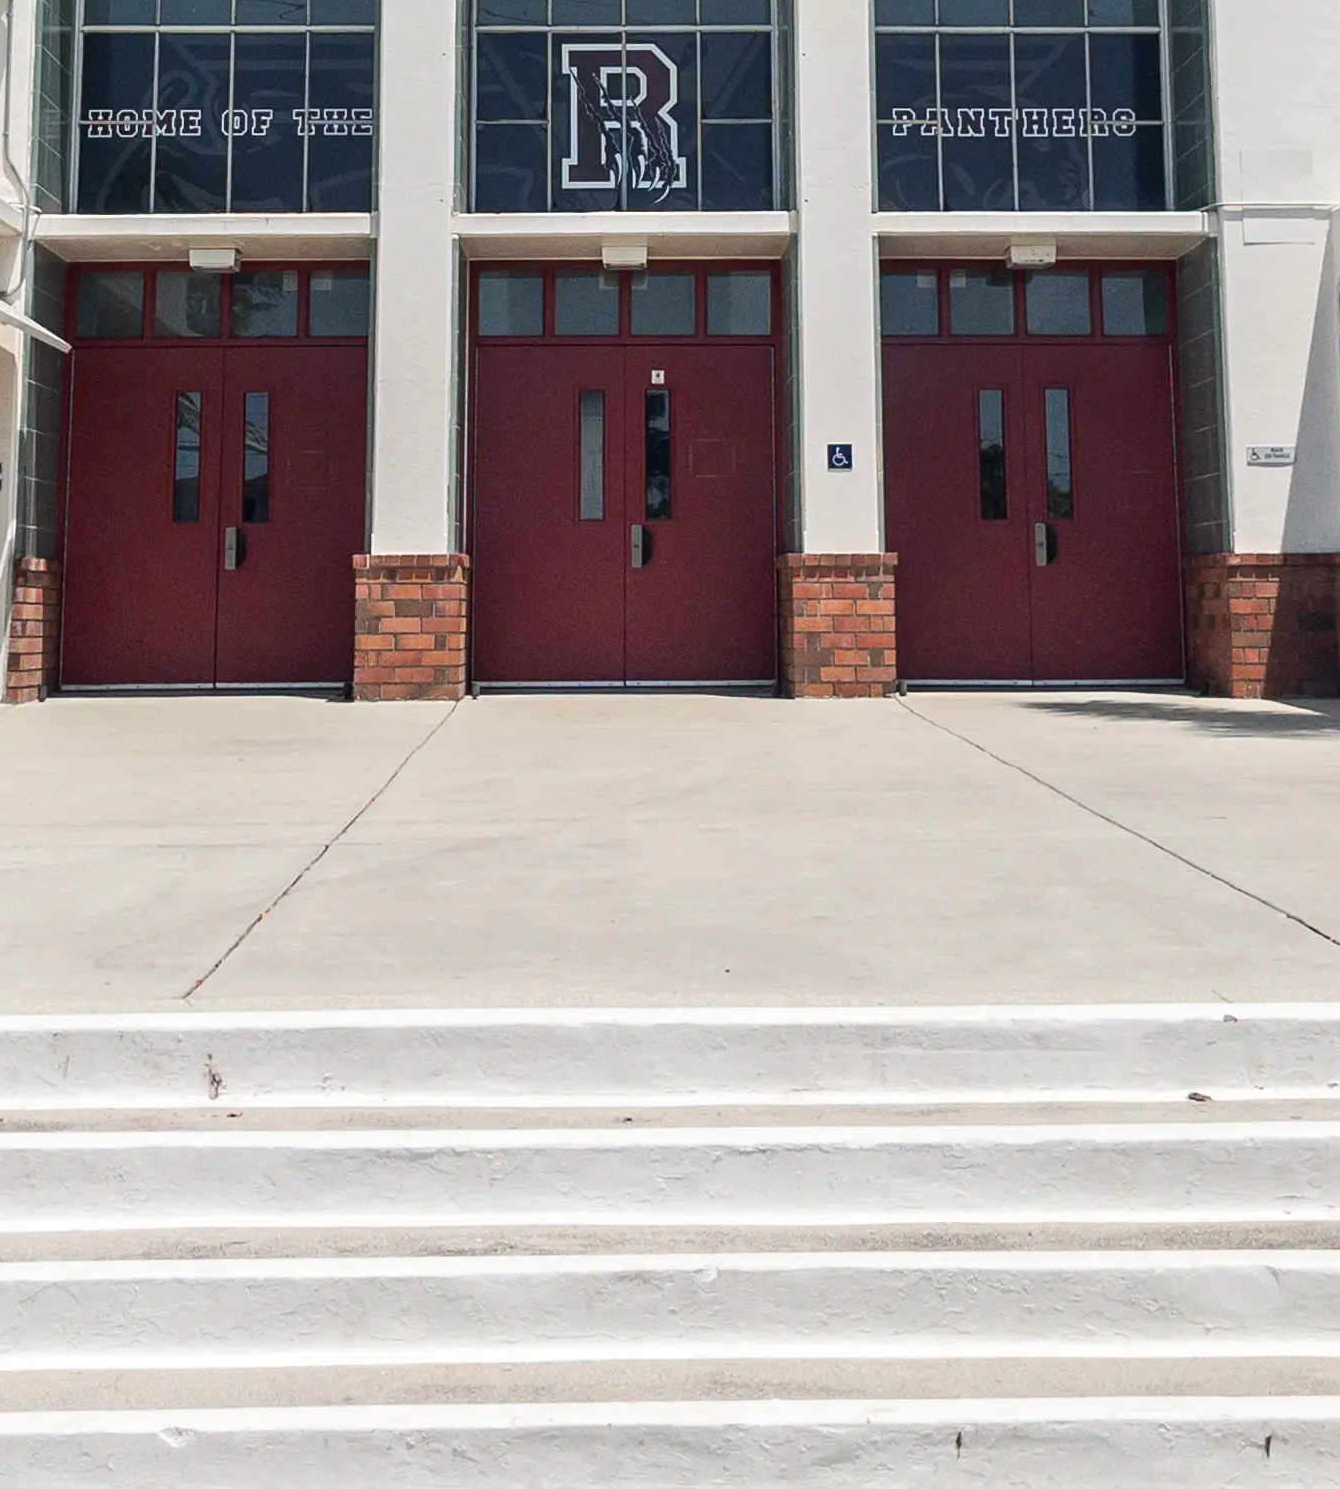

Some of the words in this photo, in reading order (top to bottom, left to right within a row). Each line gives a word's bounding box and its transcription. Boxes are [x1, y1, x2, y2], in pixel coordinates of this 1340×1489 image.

[88, 109, 201, 138] HOME
[221, 109, 273, 137] OF
[292, 108, 374, 136] THE
[561, 43, 687, 190] R
[892, 108, 1136, 138] PANTHERS
